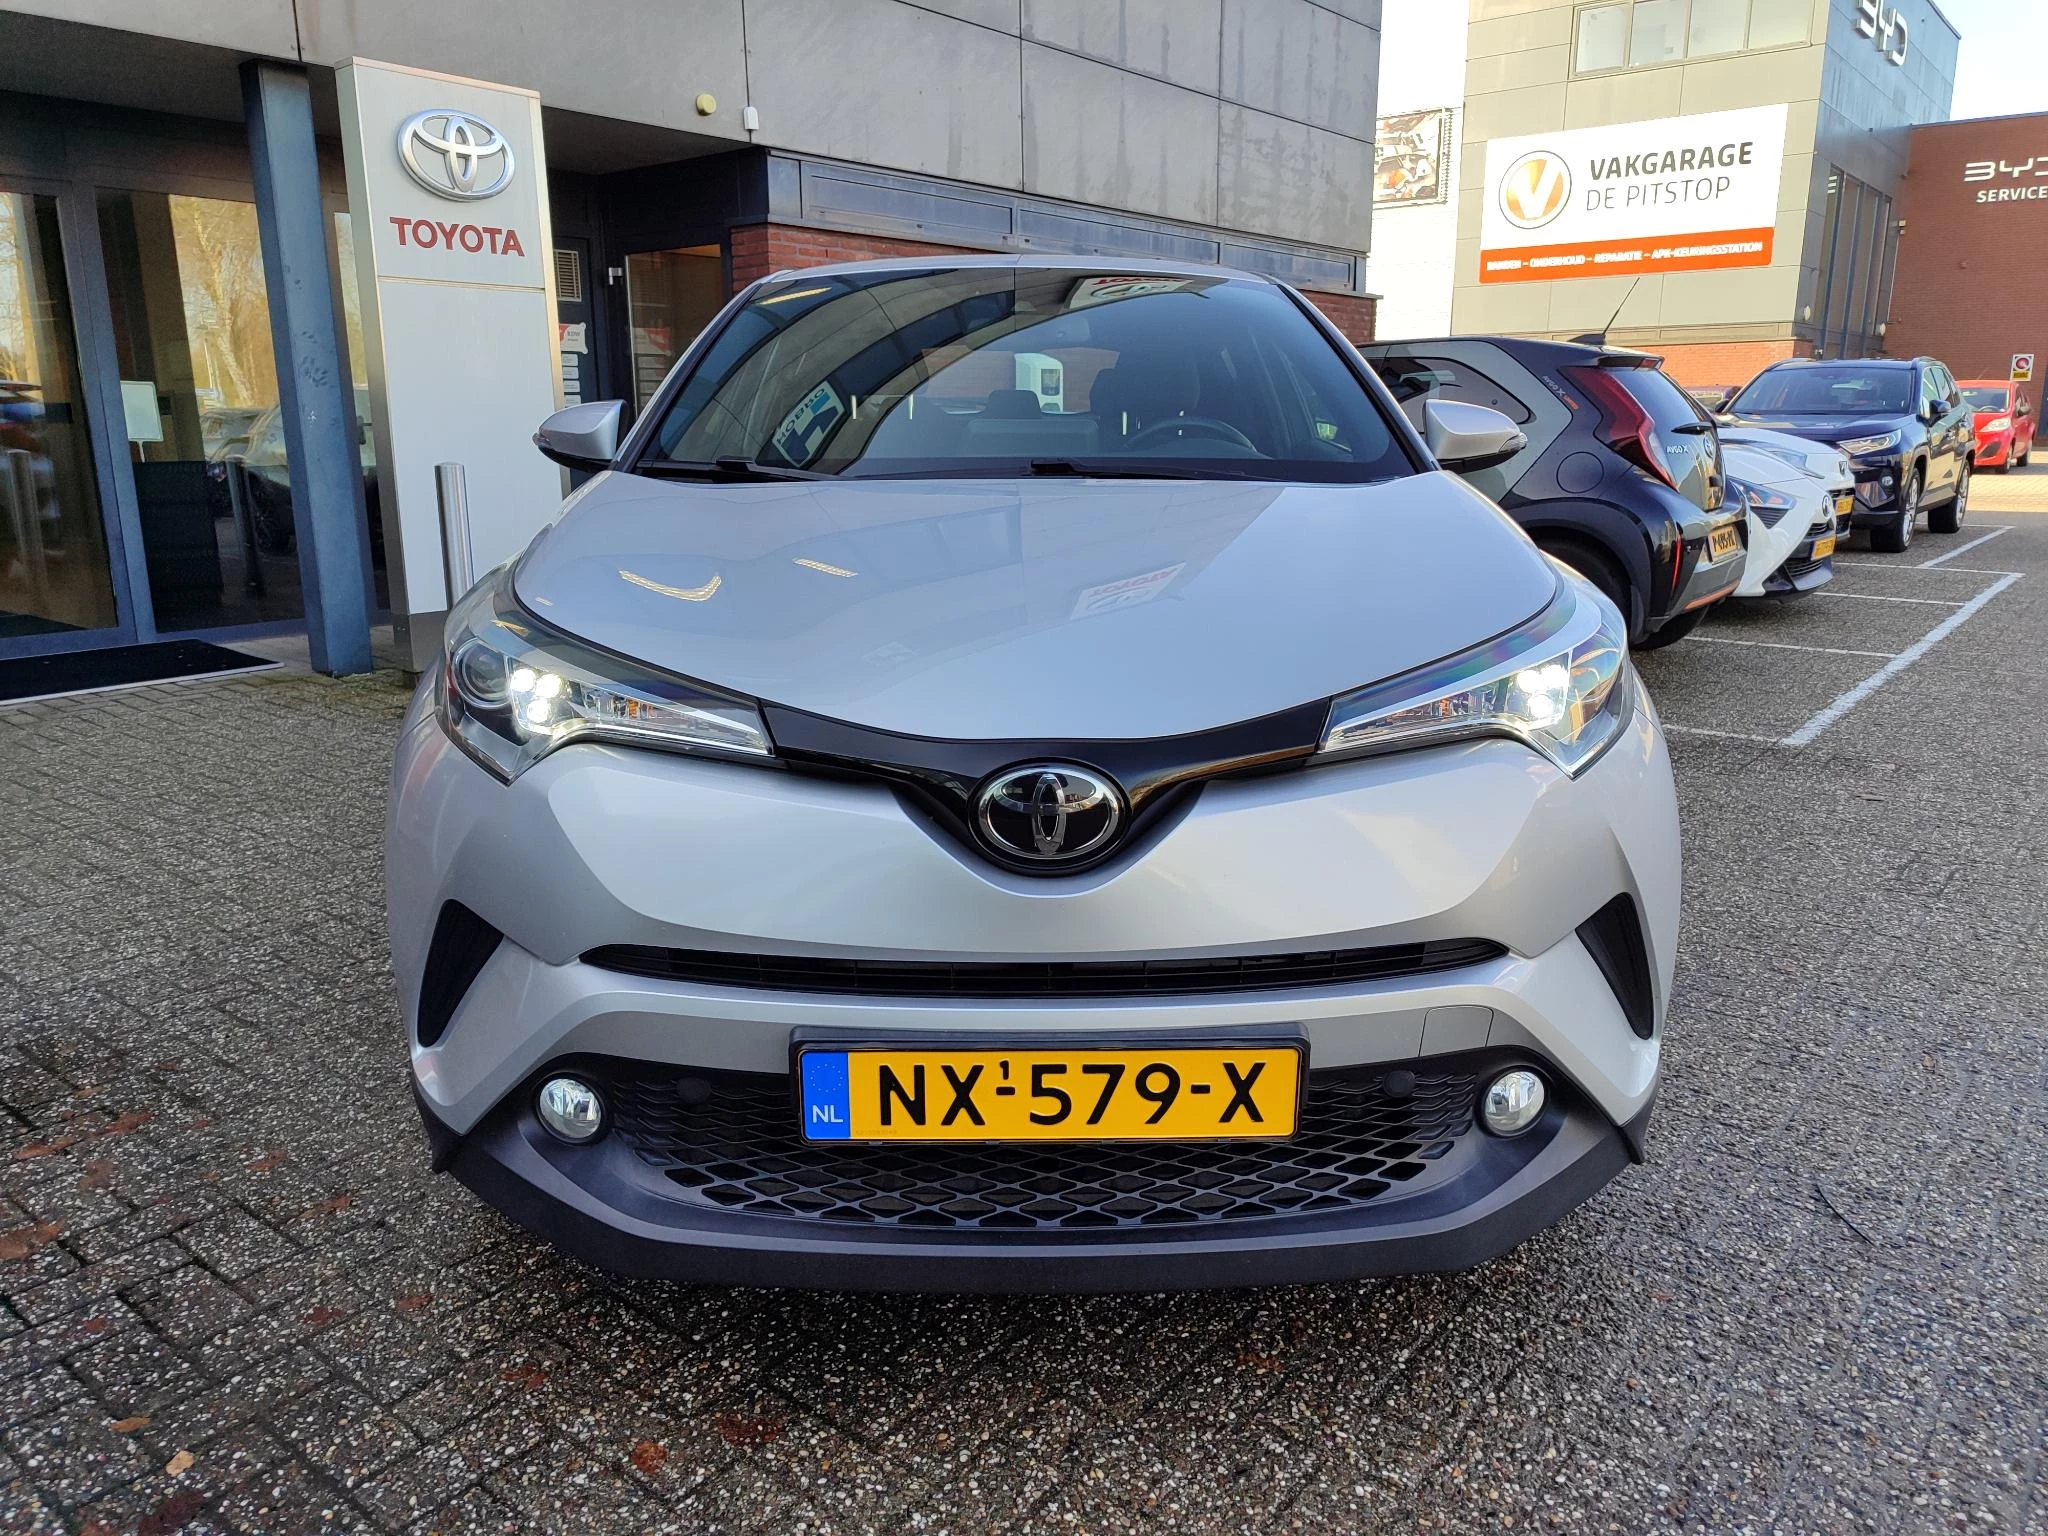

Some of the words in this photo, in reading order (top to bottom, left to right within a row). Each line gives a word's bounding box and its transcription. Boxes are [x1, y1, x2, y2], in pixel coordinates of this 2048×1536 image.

[1857, 0, 1908, 66] BYD
[1590, 141, 1753, 180] VAKGARAGE
[1586, 187, 1616, 211] DE
[1626, 176, 1731, 207] PITSTOP
[1976, 186, 2048, 203] SERVICE
[389, 216, 526, 257] TOYOTA
[812, 1104, 844, 1124] NL
